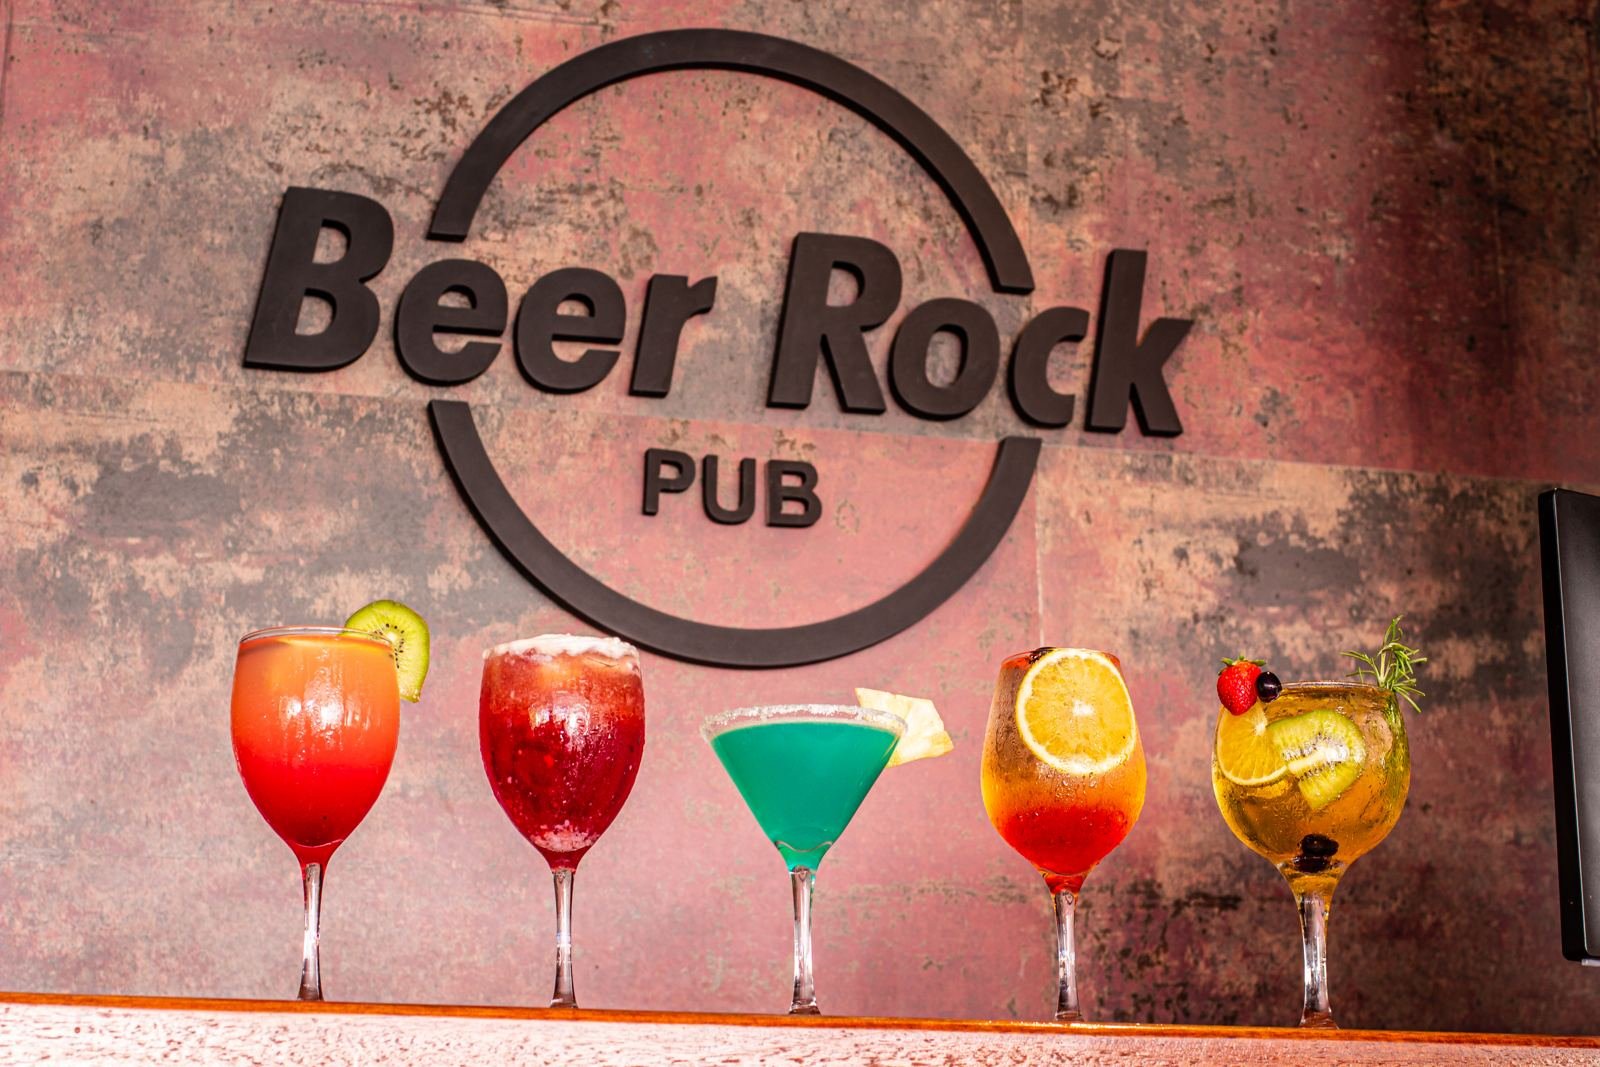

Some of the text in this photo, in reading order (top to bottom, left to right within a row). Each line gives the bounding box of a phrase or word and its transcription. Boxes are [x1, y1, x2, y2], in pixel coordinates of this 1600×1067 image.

[243, 186, 1195, 439] Beer Rock
[642, 448, 823, 529] PUB
